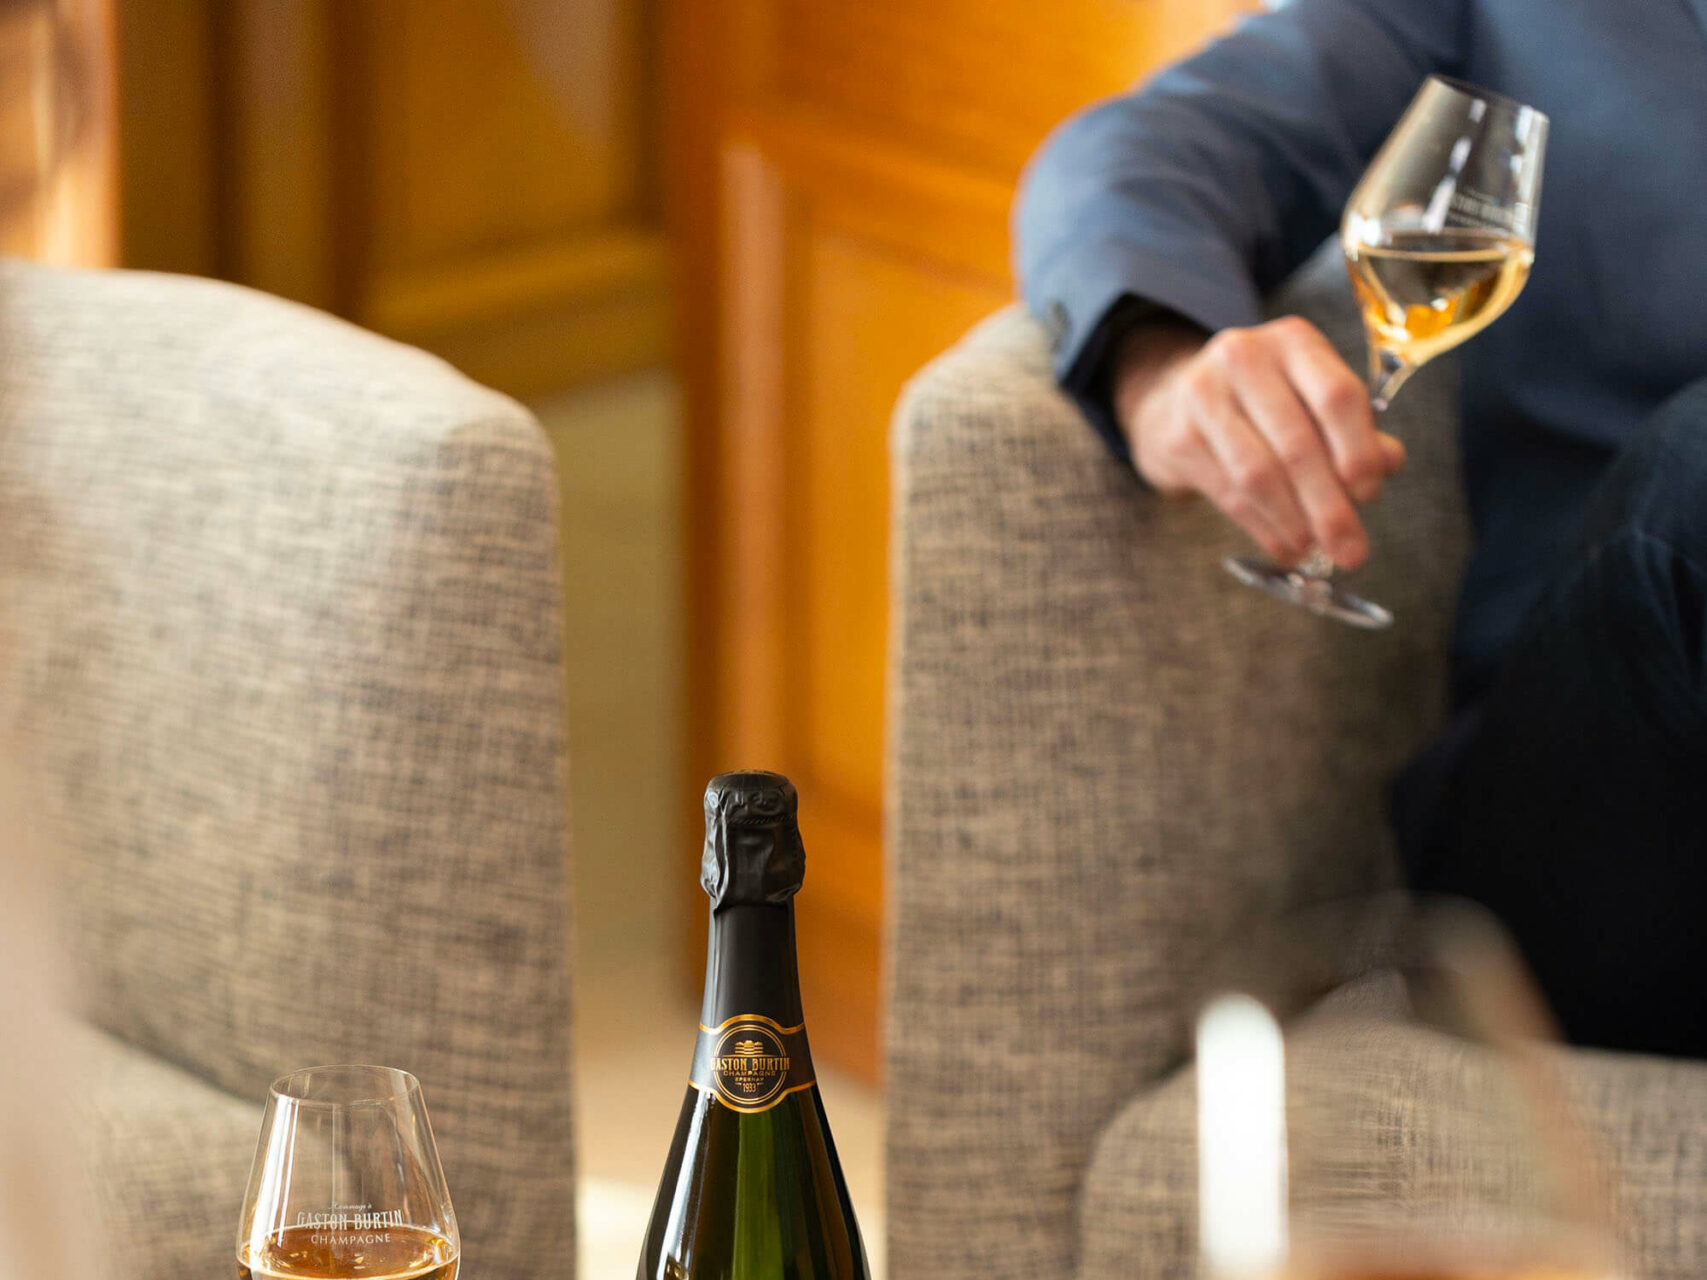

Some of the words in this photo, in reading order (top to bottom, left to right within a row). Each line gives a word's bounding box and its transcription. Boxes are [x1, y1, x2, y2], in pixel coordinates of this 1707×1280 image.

[752, 1057, 790, 1071] BURTIN
[297, 1211, 347, 1231] GASTON
[354, 1209, 403, 1230] BURTIN
[311, 1233, 391, 1245] CHAMPAGNE
